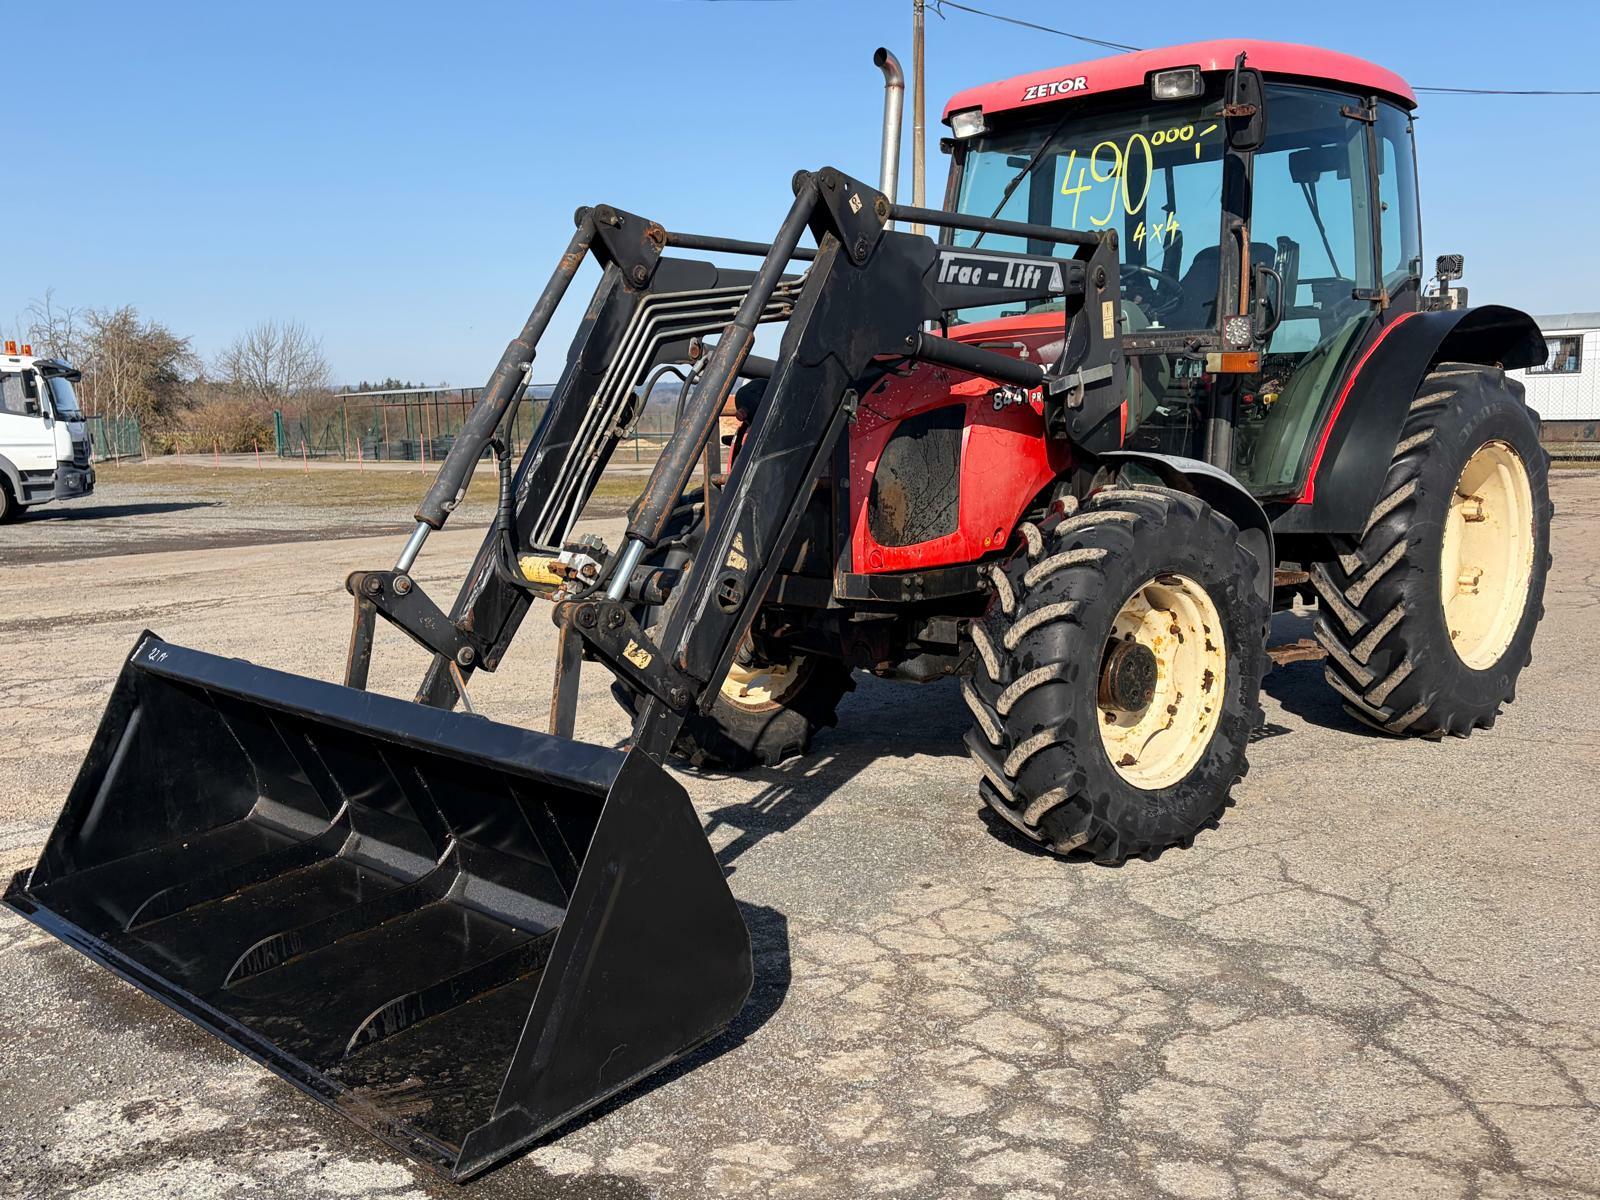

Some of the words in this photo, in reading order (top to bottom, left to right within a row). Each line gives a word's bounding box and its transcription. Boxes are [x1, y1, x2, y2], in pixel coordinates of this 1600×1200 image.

[1022, 76, 1088, 101] ZETOR
[938, 251, 982, 285] Trac
[1003, 261, 1042, 289] Lift
